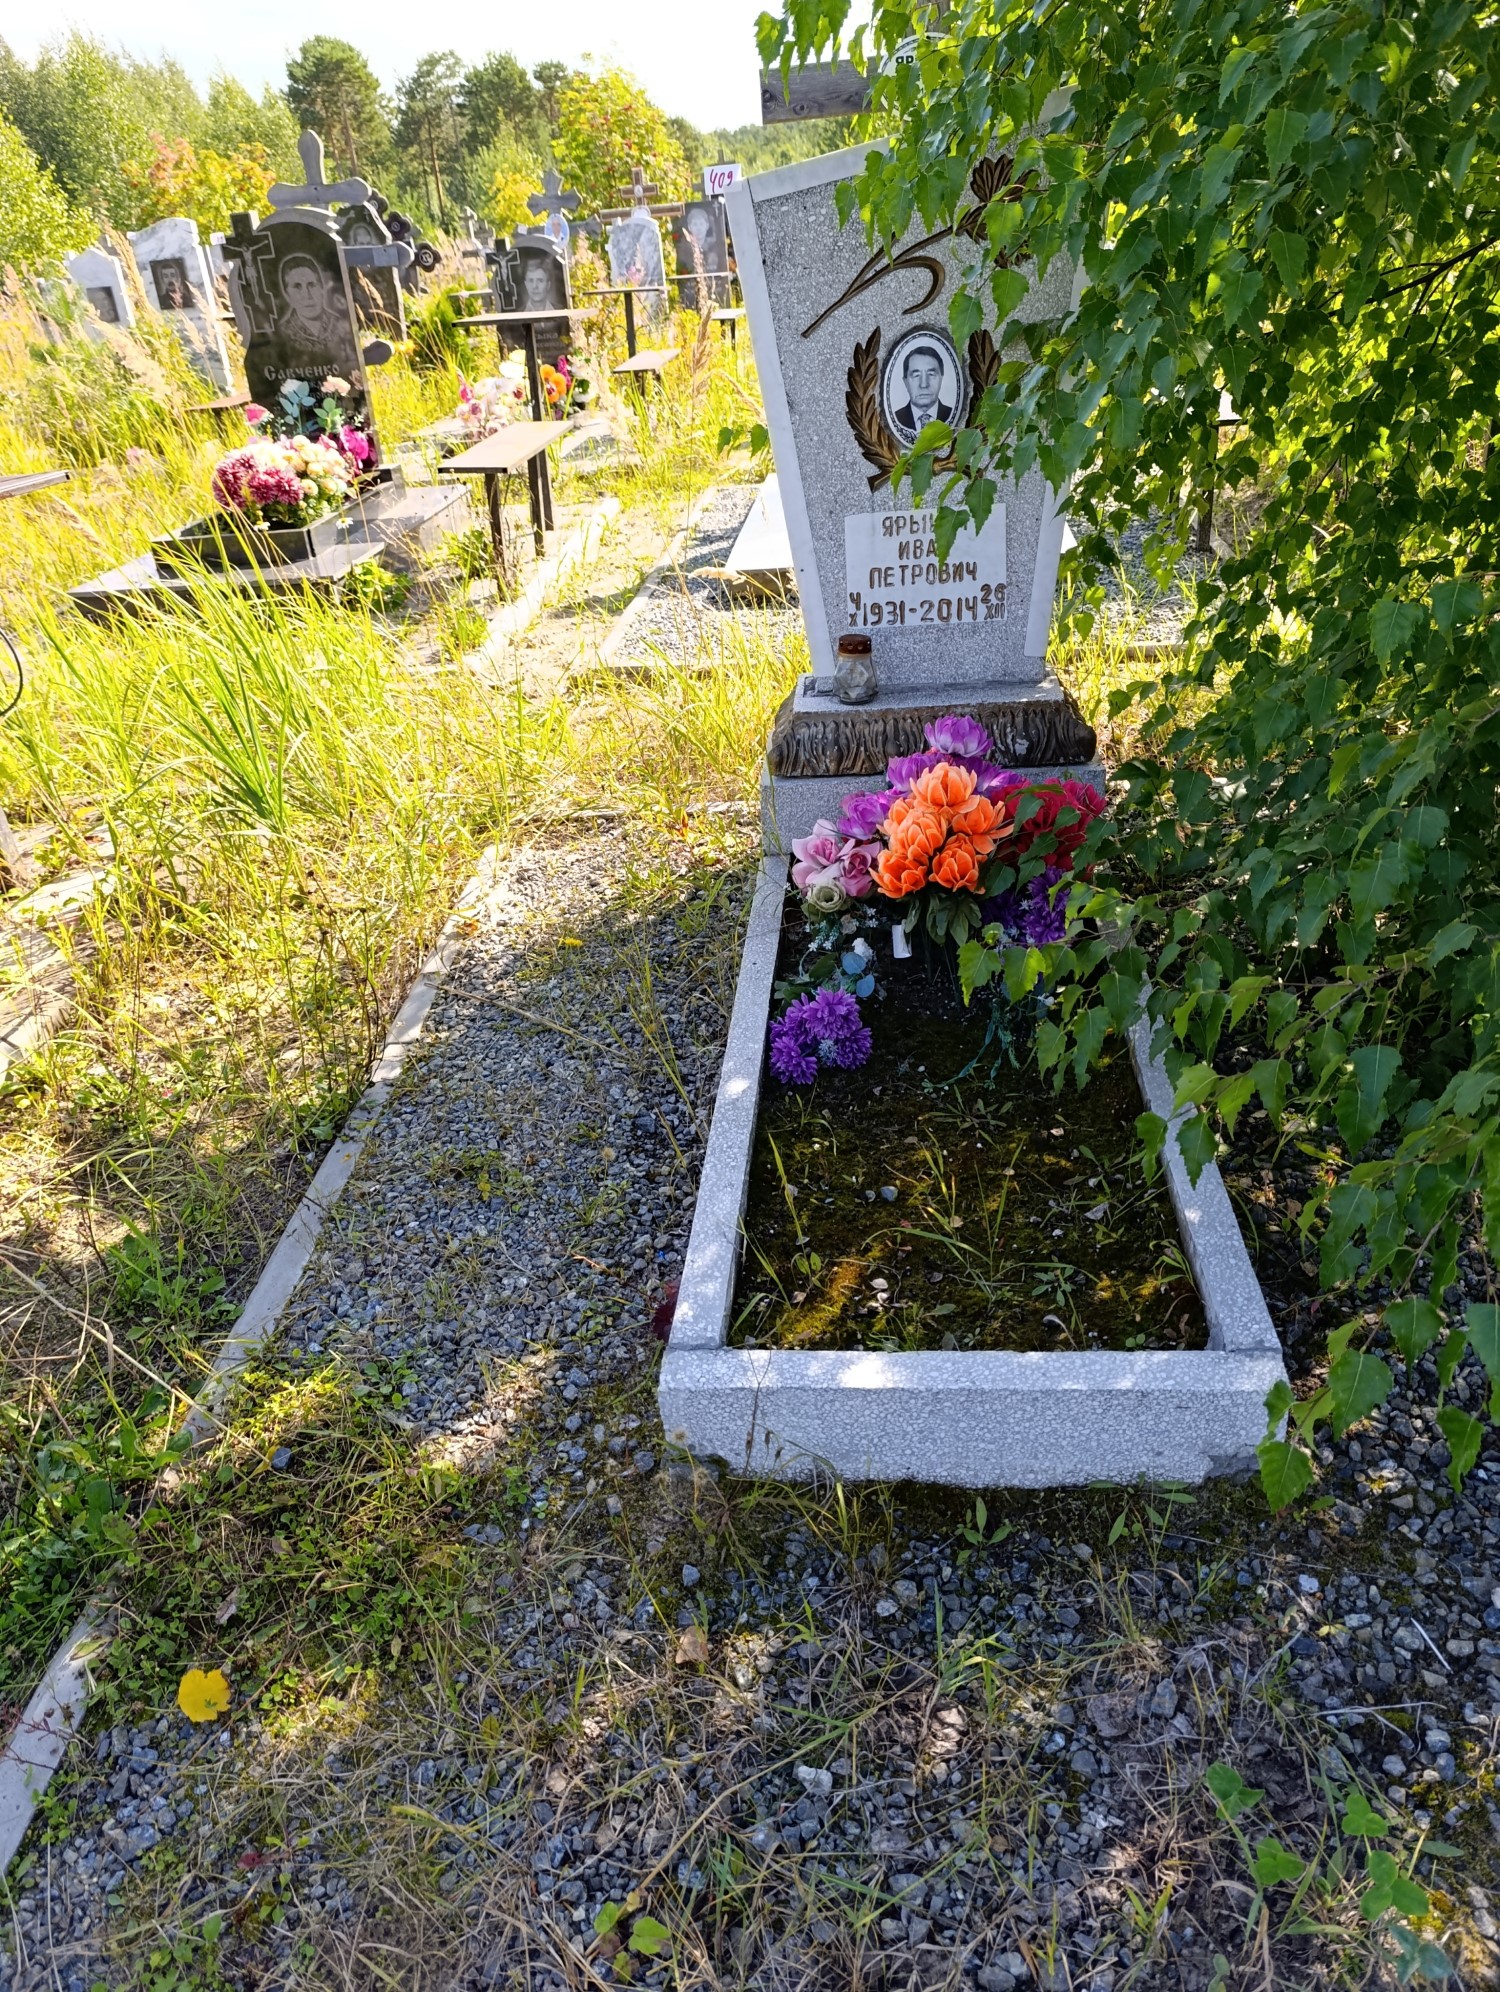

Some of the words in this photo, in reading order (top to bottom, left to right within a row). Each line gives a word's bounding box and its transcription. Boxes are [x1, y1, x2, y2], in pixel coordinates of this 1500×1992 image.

[710, 169, 733, 194] 409
[898, 538, 948, 561] ИВА
[869, 561, 978, 589] ПЕТРОВИЧ
[980, 583, 1006, 604] 26
